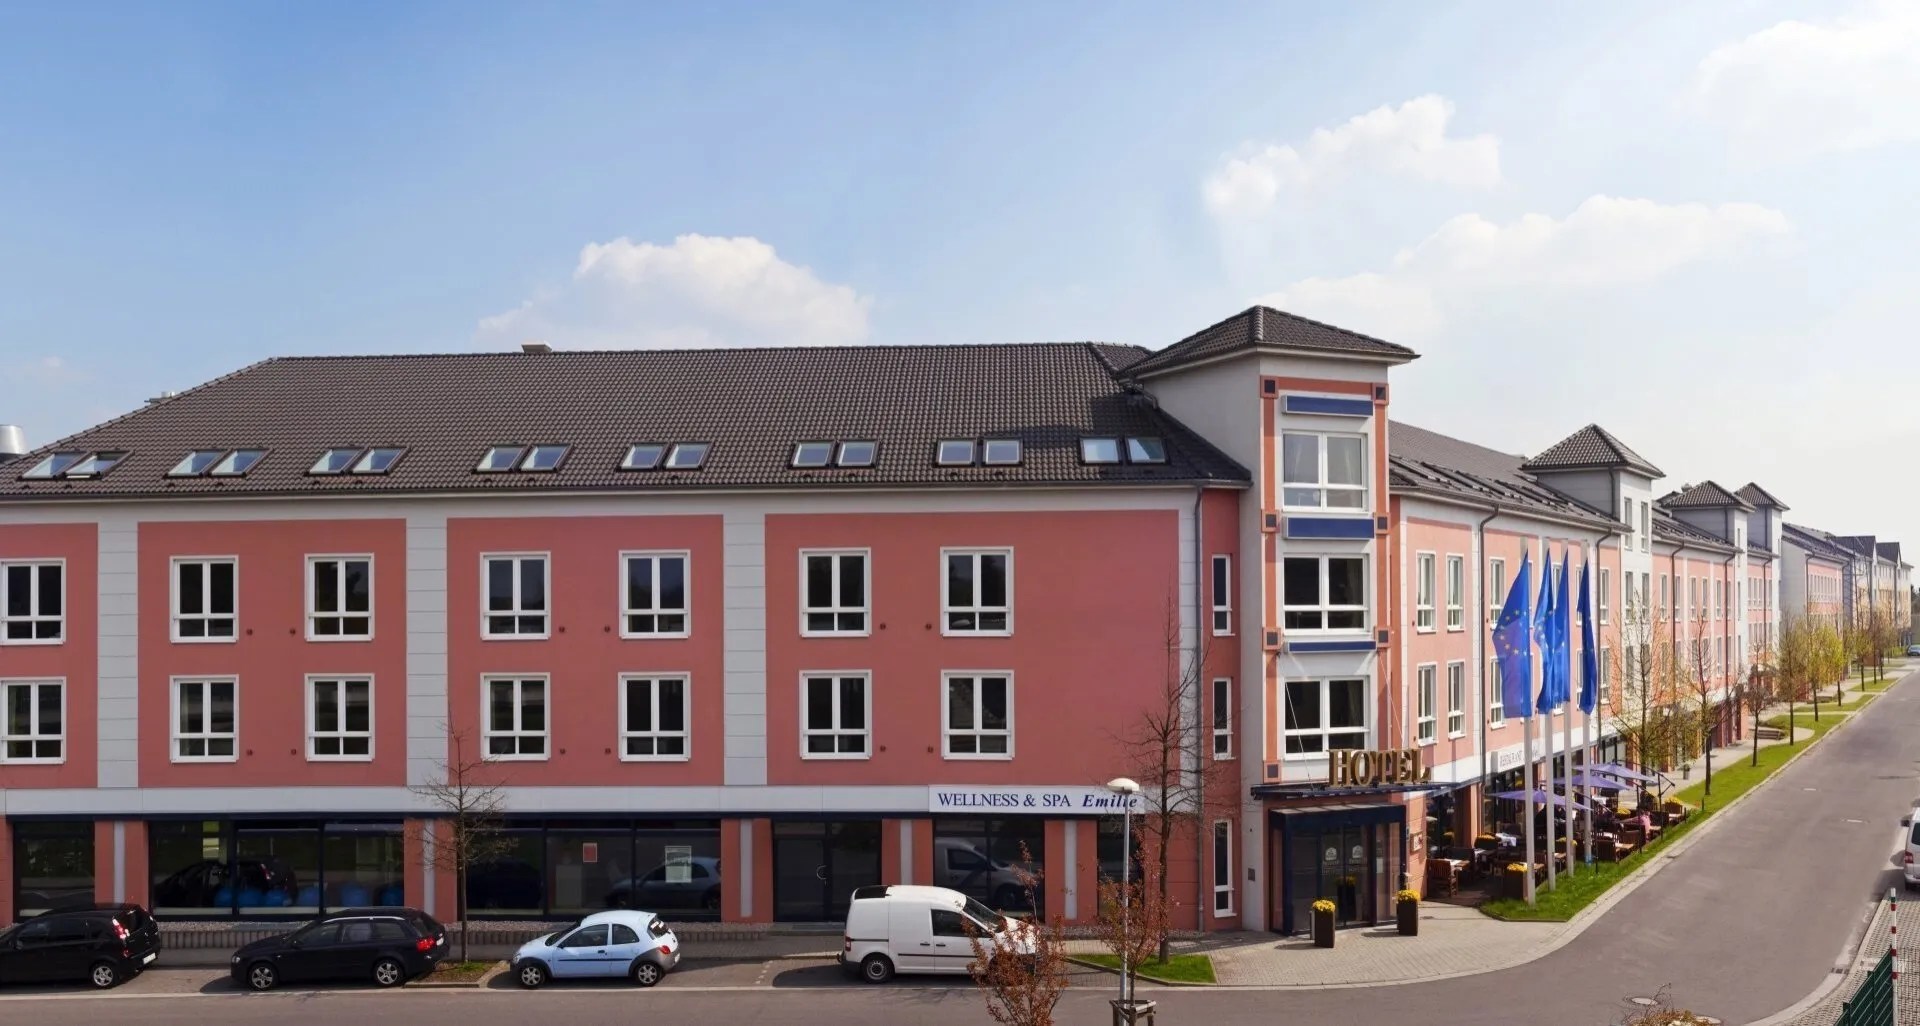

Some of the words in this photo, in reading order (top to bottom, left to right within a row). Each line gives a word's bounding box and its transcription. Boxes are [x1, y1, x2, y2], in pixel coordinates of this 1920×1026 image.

[1327, 748, 1432, 788] HOTEL
[937, 792, 1019, 807] WELLNESS
[1023, 793, 1036, 807] &
[1042, 793, 1072, 807] SPA
